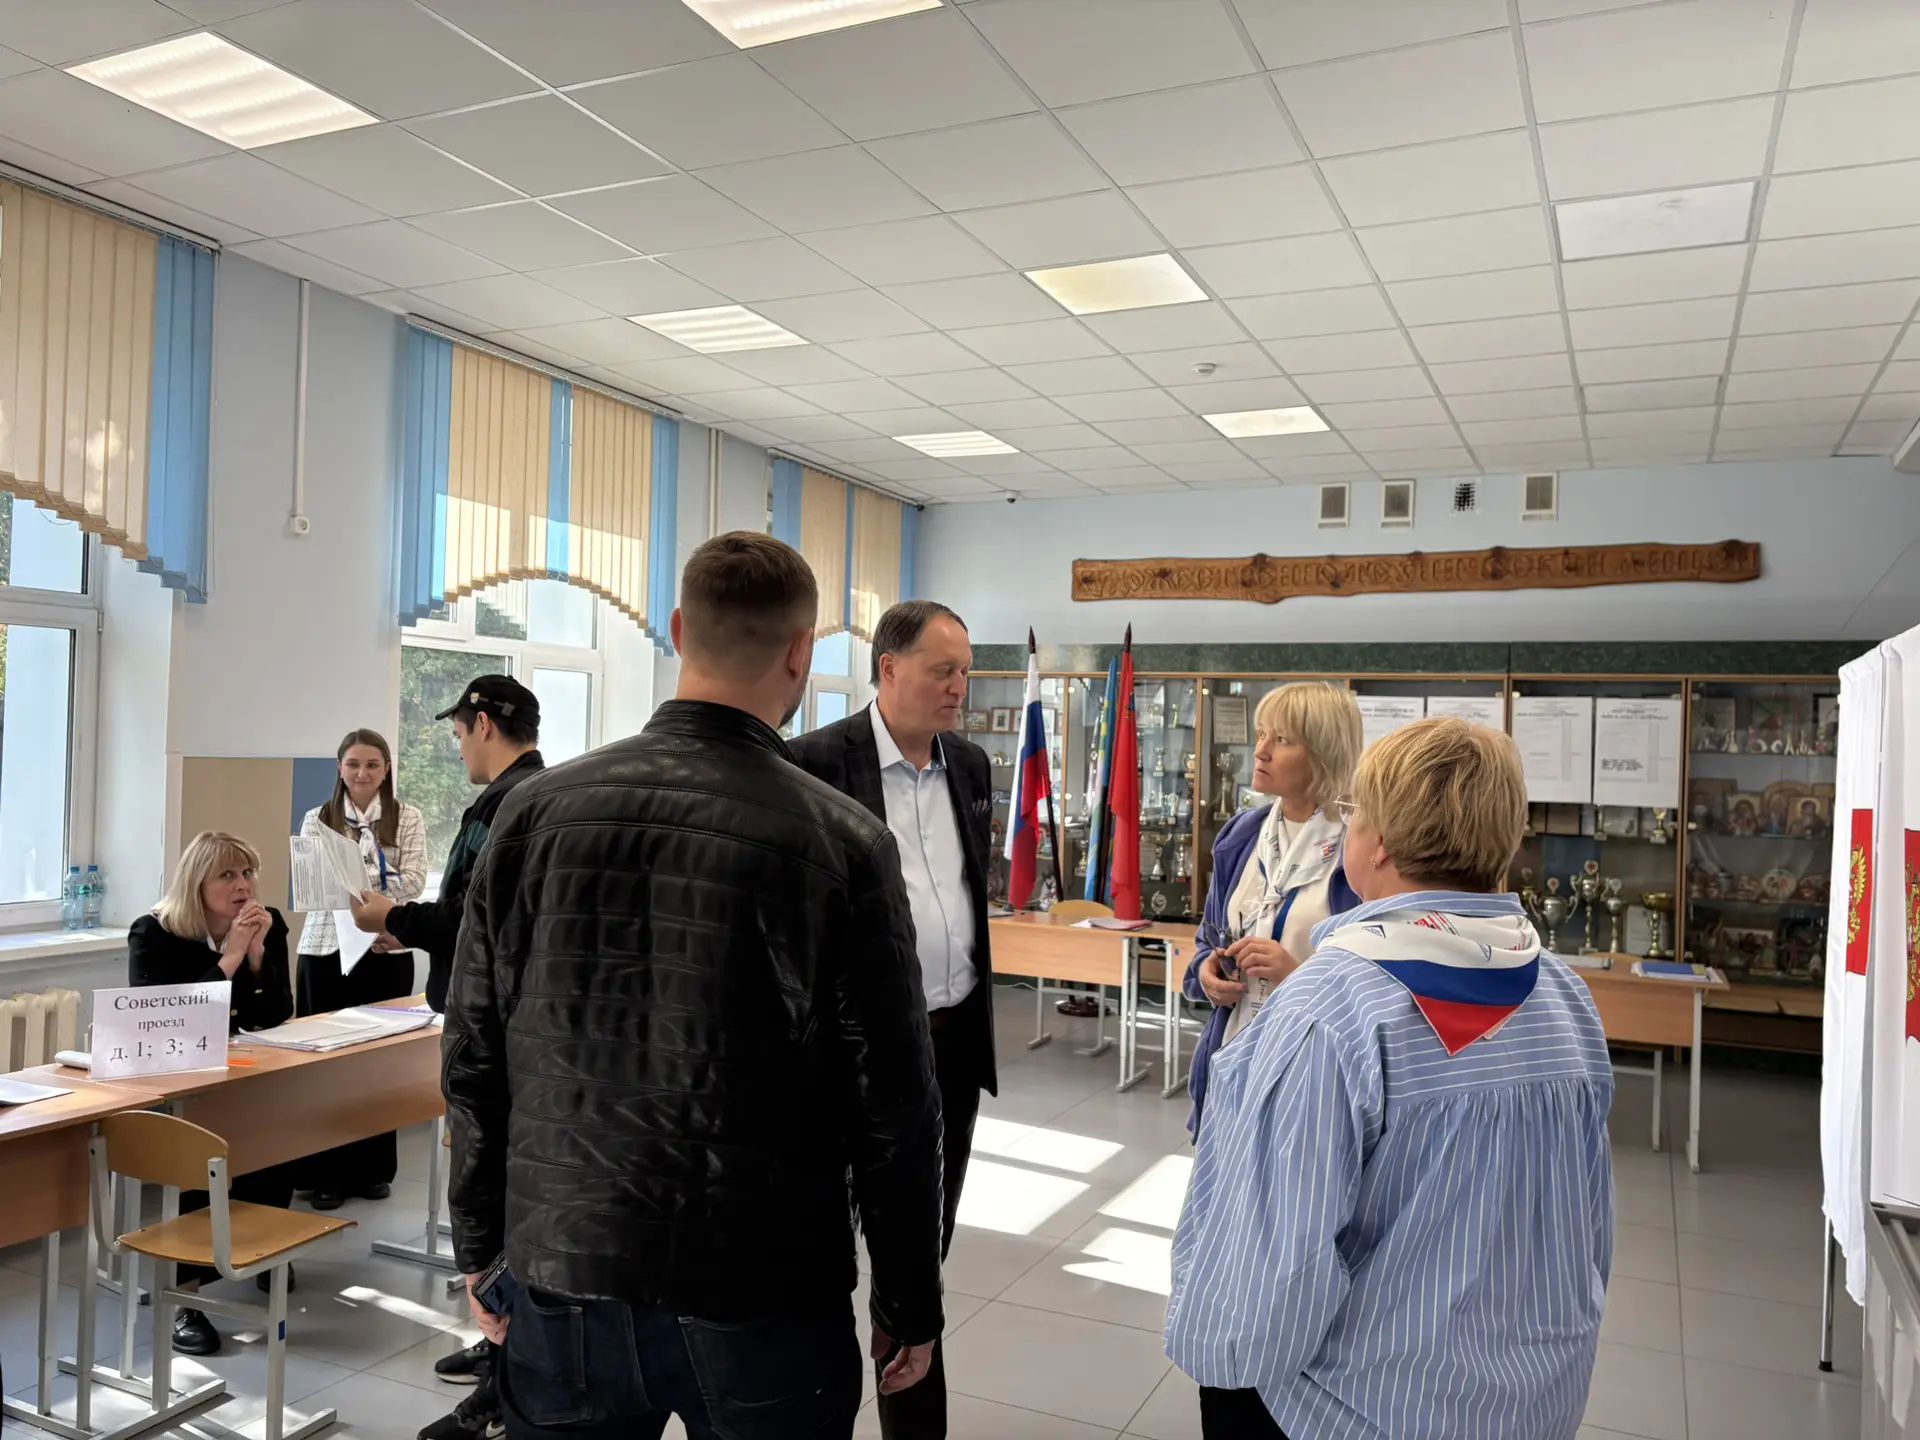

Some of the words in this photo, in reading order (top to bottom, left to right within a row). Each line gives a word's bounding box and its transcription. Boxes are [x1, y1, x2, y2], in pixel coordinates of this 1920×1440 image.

[114, 990, 209, 1011] Советский
[138, 1017, 185, 1032] проезд
[110, 1047, 129, 1062] д.
[136, 1041, 152, 1060] 1;
[165, 1038, 183, 1056] 3;
[196, 1035, 208, 1052] 4
